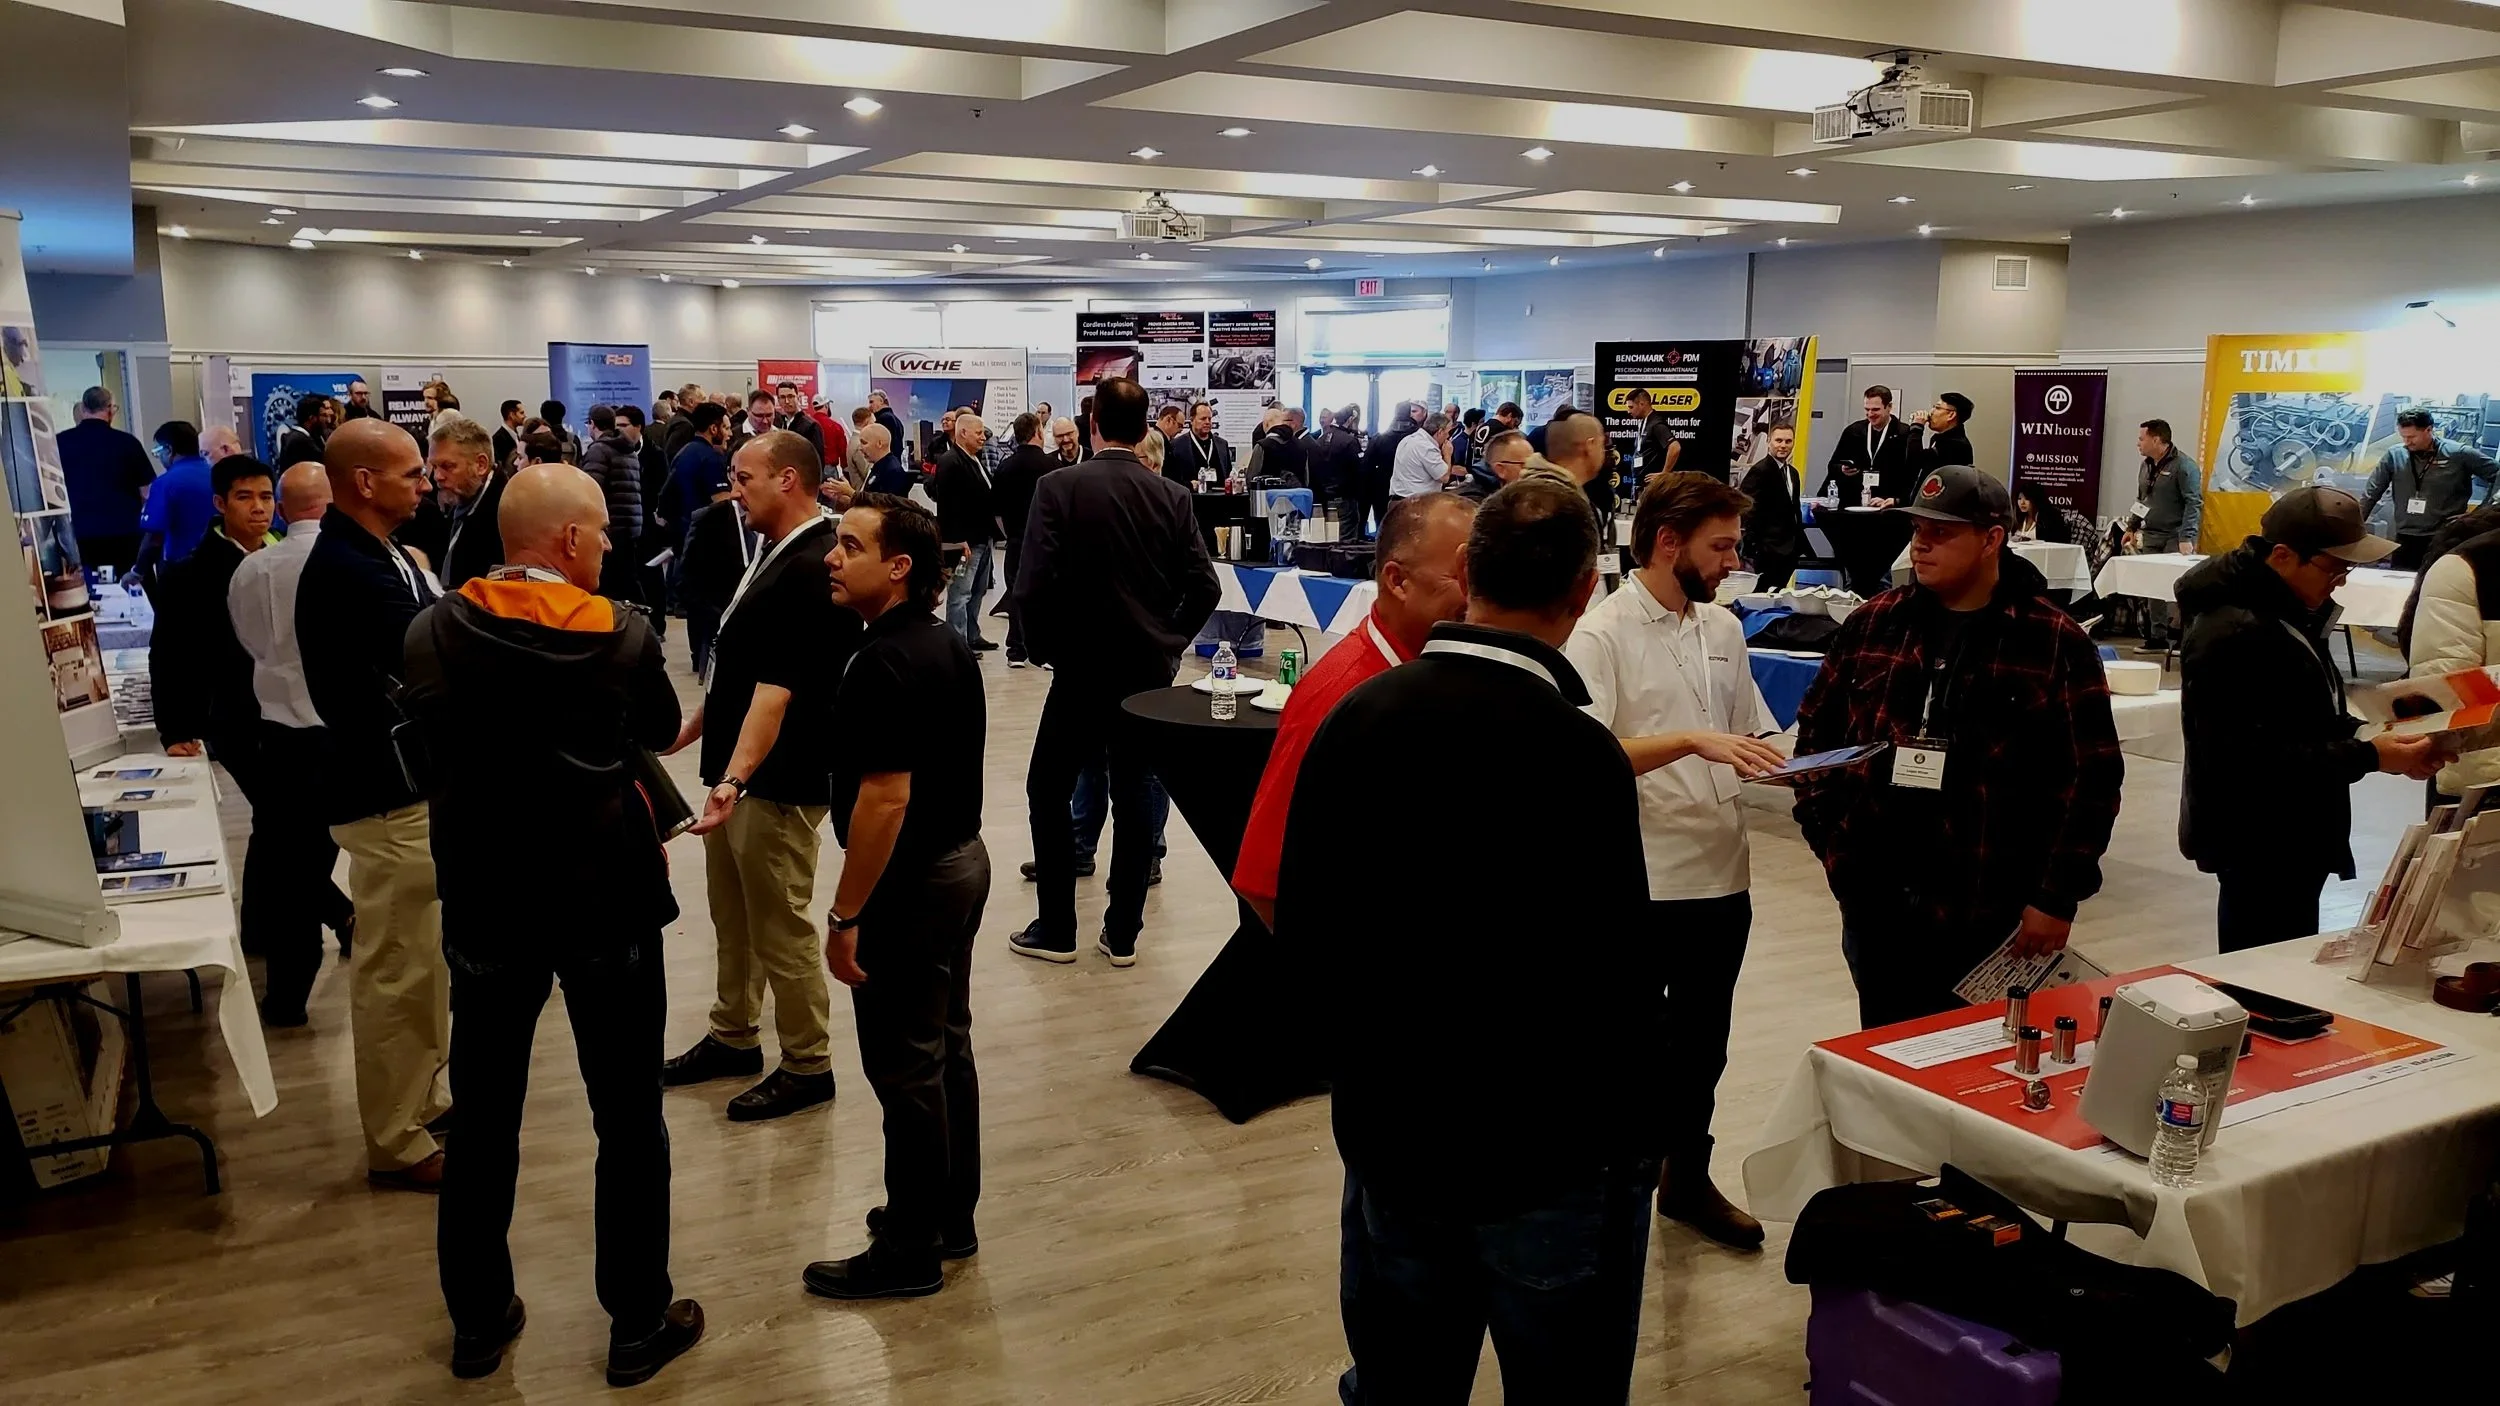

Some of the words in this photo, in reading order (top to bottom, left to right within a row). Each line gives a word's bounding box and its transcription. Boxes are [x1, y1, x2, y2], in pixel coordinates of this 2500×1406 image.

[1360, 280, 1378, 295] EXIT
[1107, 321, 1134, 329] Explosion
[1615, 354, 1665, 363] BENCHMARK
[1682, 353, 1700, 362] PDM
[900, 360, 963, 371] WCHE
[388, 401, 427, 411] RELIAB
[1605, 417, 1621, 426] The
[1690, 417, 1701, 426] for
[2020, 422, 2092, 436] WINhouse
[2035, 454, 2079, 464] MISSION
